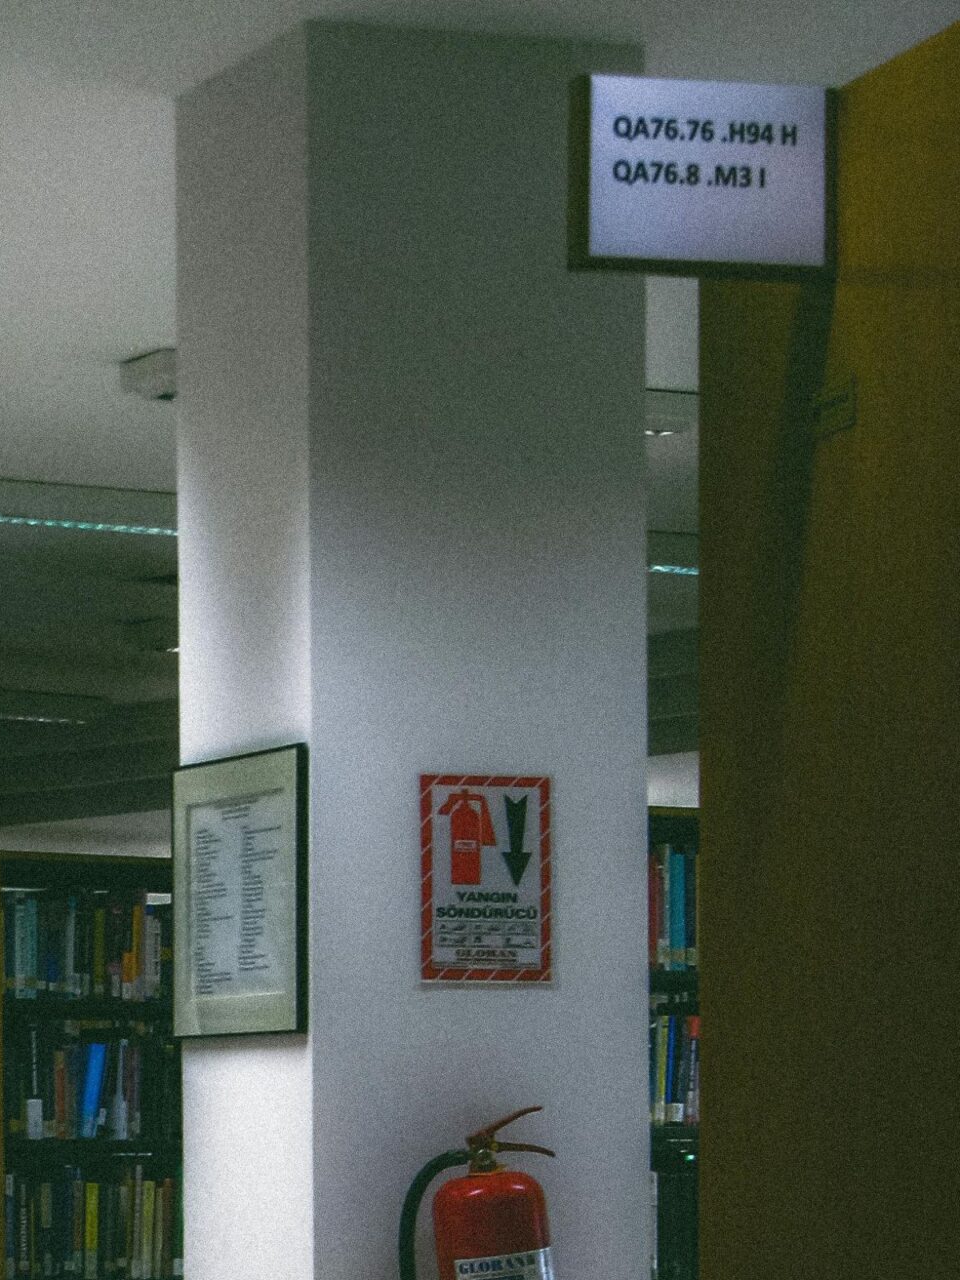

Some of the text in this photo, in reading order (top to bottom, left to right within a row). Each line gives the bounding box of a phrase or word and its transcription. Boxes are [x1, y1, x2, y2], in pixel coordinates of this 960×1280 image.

[612, 115, 798, 146] QA76.76 .H94 H
[612, 159, 700, 186] QA76.8
[707, 165, 752, 188] .M3
[456, 891, 518, 903] YANGIN
[436, 904, 538, 919] SÖNDÜRÜCÜ
